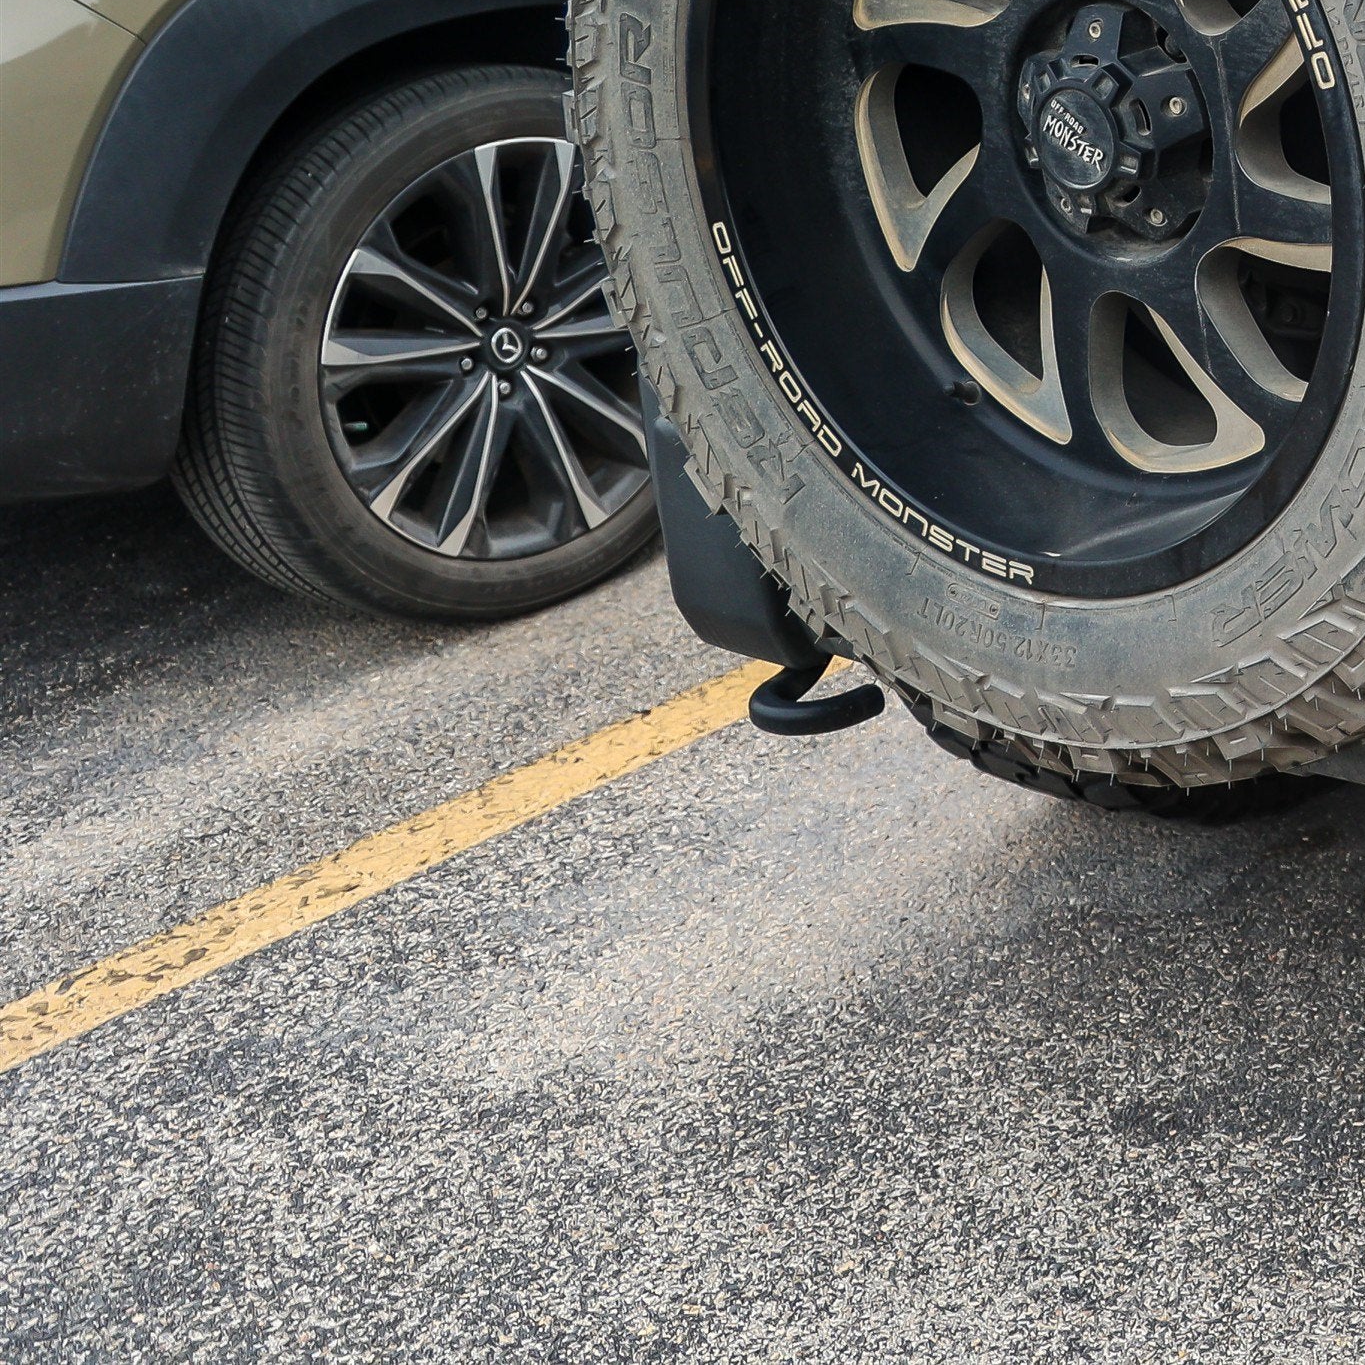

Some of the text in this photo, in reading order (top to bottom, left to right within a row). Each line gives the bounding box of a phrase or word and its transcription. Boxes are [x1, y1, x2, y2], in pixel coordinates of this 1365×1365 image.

[1042, 115, 1104, 173] MONSTER
[1050, 99, 1085, 135] OFF-ROAD
[712, 222, 1035, 585] OFF-ROAD MONSTER
[915, 593, 1078, 667] 33X12.50R20LT
